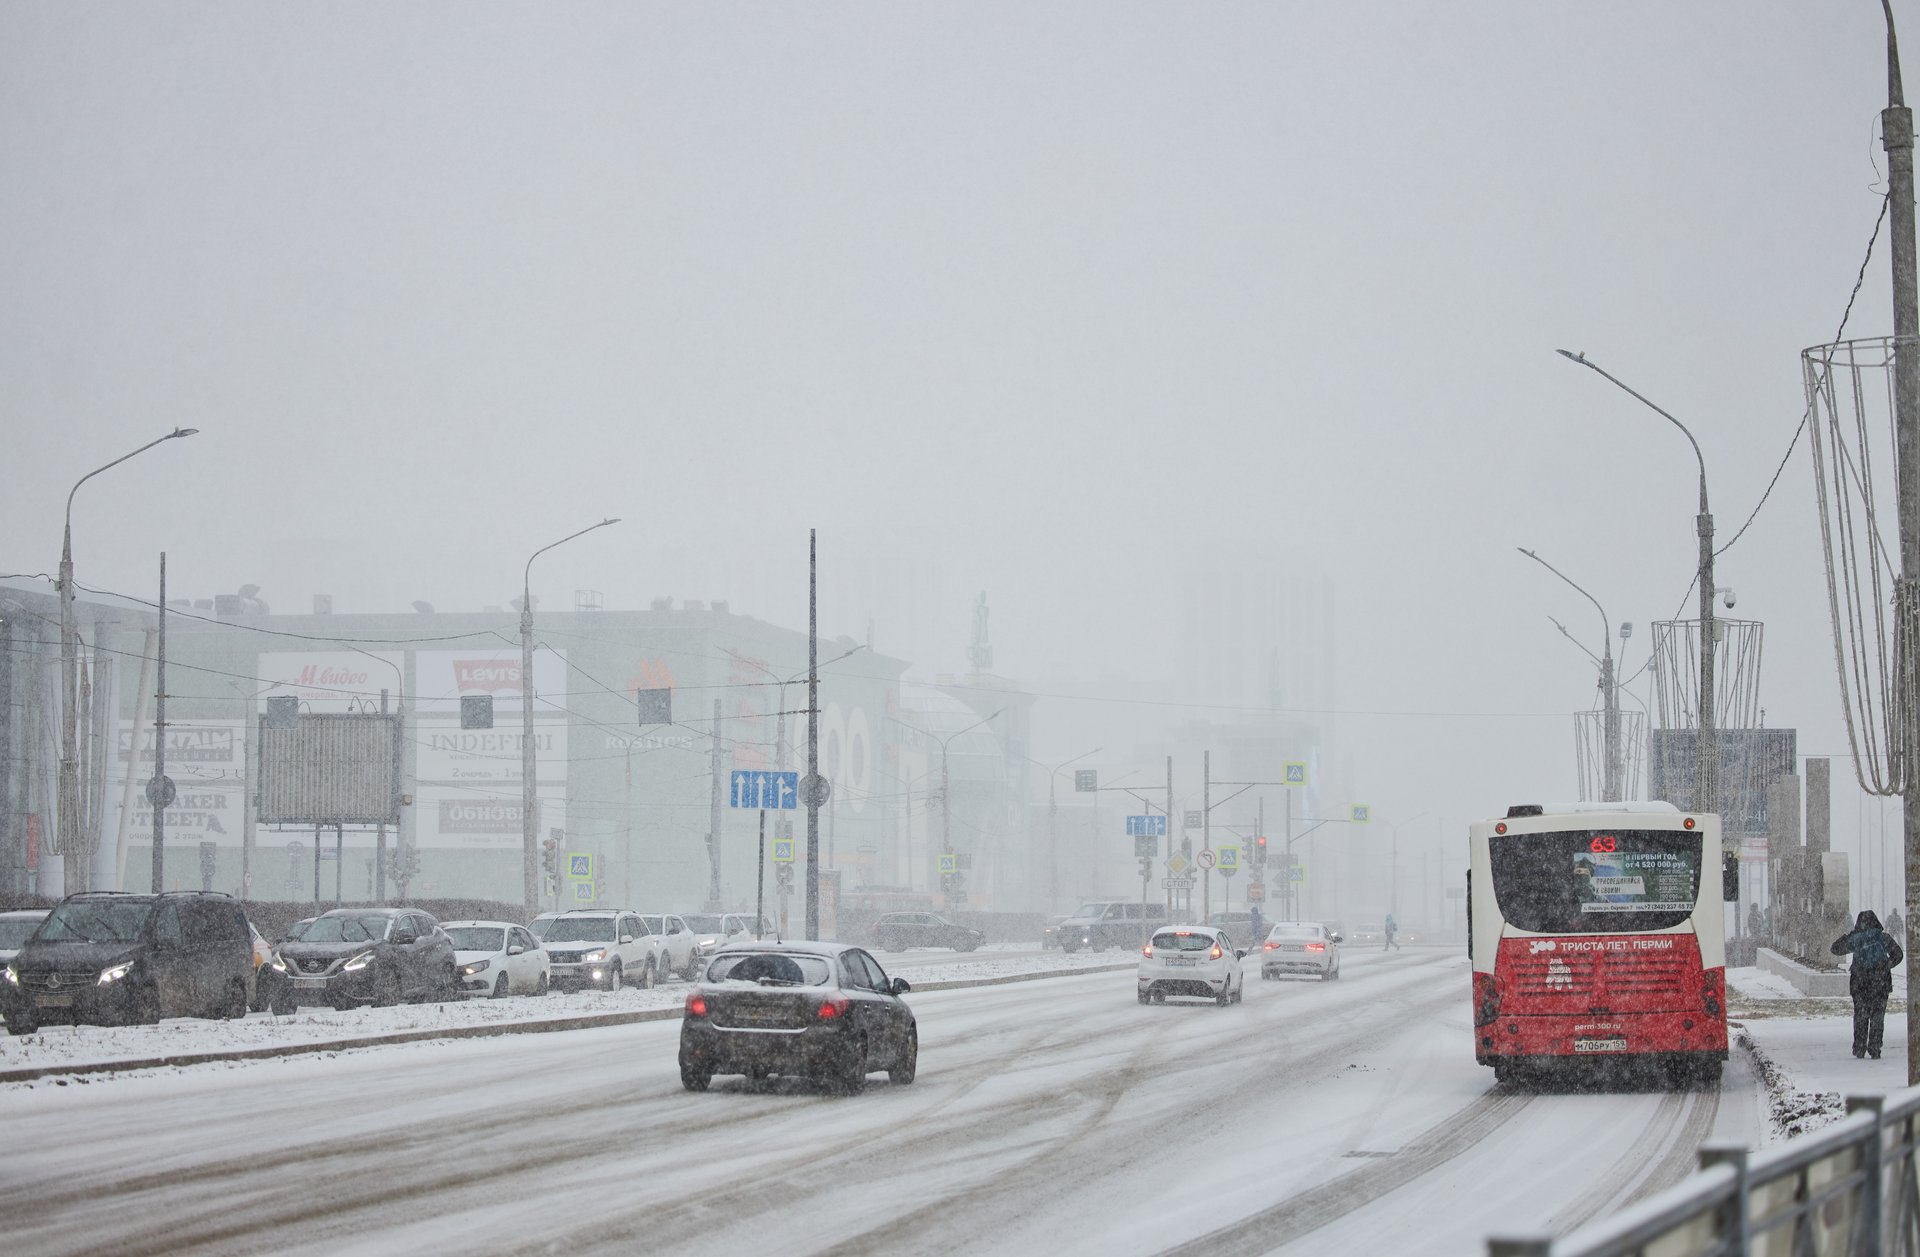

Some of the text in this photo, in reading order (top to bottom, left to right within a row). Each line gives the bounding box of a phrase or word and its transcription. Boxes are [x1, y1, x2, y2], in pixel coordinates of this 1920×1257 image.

[132, 795, 227, 809] NAKER
[130, 812, 207, 826] TEET
[1590, 836, 1616, 852] 63
[1631, 852, 1661, 861] ПЕРВЫЙ
[1663, 853, 1677, 861] ГОД
[1166, 879, 1190, 888] СТОП
[1561, 942, 1604, 951] ТРИСТА
[1606, 941, 1628, 950] ЛЕТ
[1633, 940, 1673, 950] ПЕРМИ
